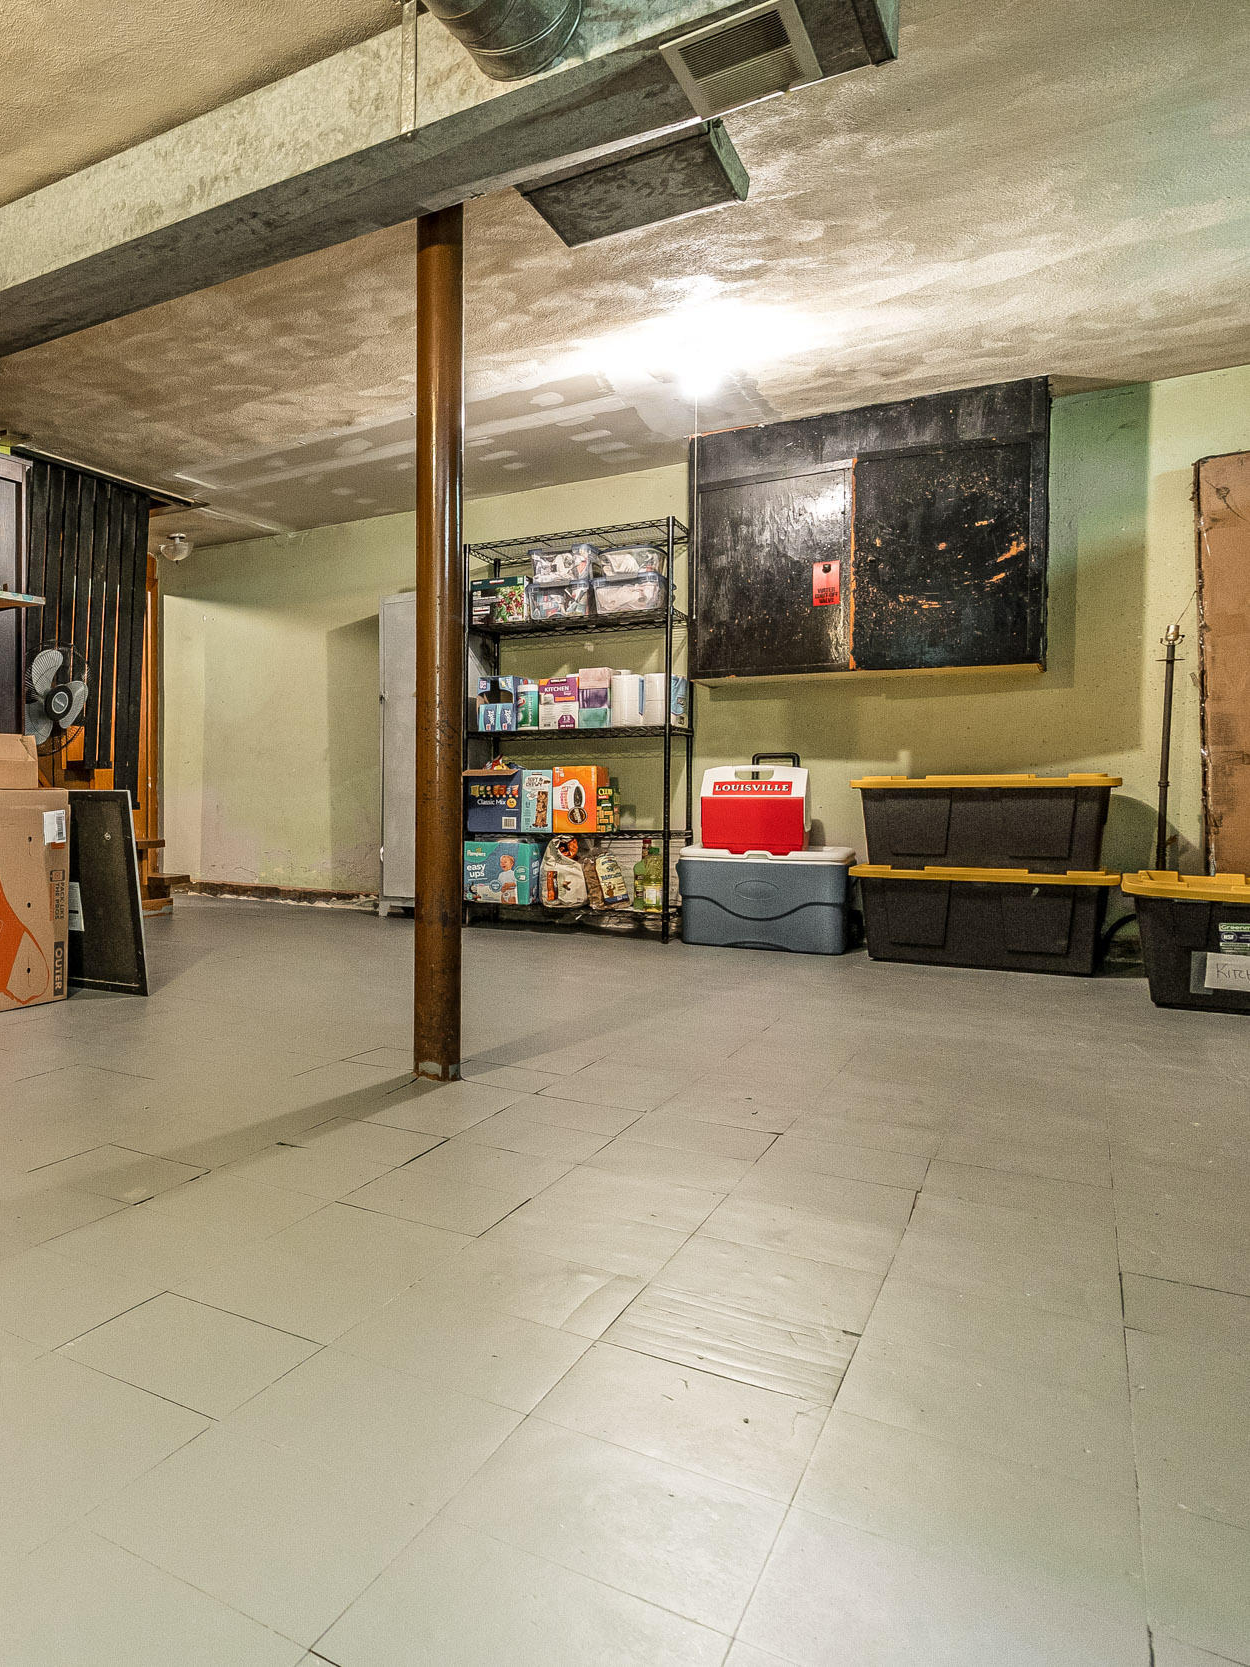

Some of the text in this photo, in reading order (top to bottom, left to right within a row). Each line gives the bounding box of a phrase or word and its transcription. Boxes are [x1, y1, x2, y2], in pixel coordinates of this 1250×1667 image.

[467, 863, 486, 871] easy
[470, 870, 485, 878] ups
[54, 946, 63, 990] OUTER
